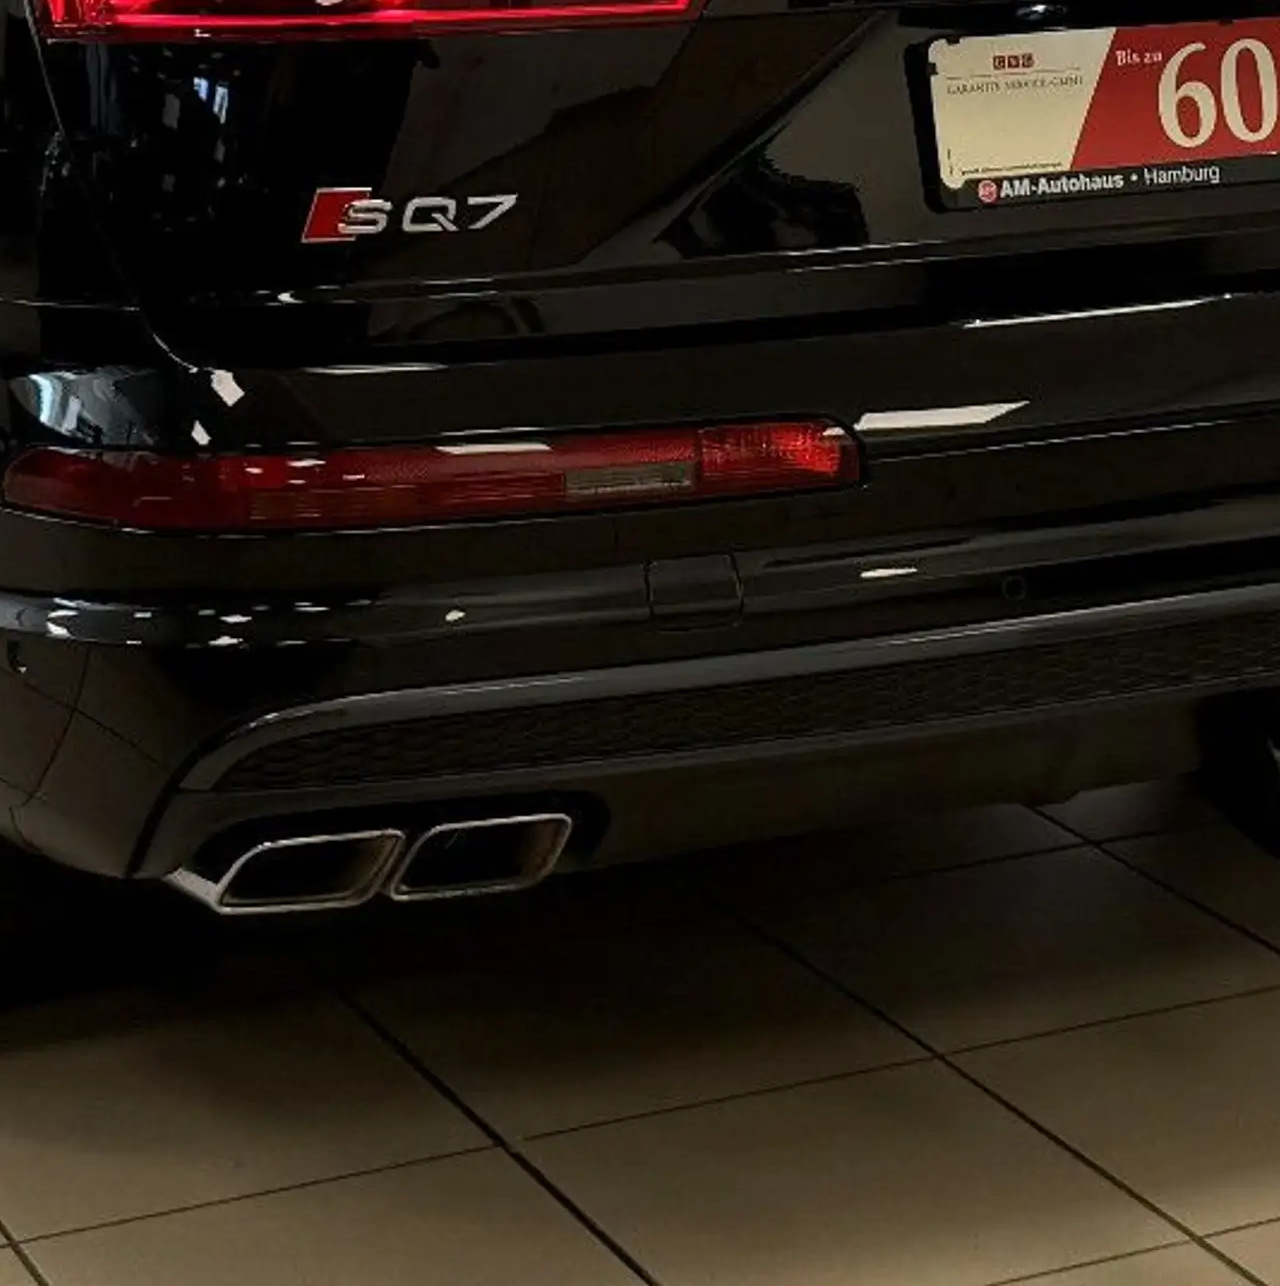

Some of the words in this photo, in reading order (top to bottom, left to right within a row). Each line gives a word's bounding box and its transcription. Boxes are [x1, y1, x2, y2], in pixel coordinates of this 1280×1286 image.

[1115, 49, 1140, 67] Bis
[1143, 51, 1163, 65] zu
[1157, 37, 1278, 149] 60
[999, 171, 1125, 199] AM-Autohaus
[1143, 164, 1221, 186] Hamburg
[337, 192, 519, 235] SQ7
